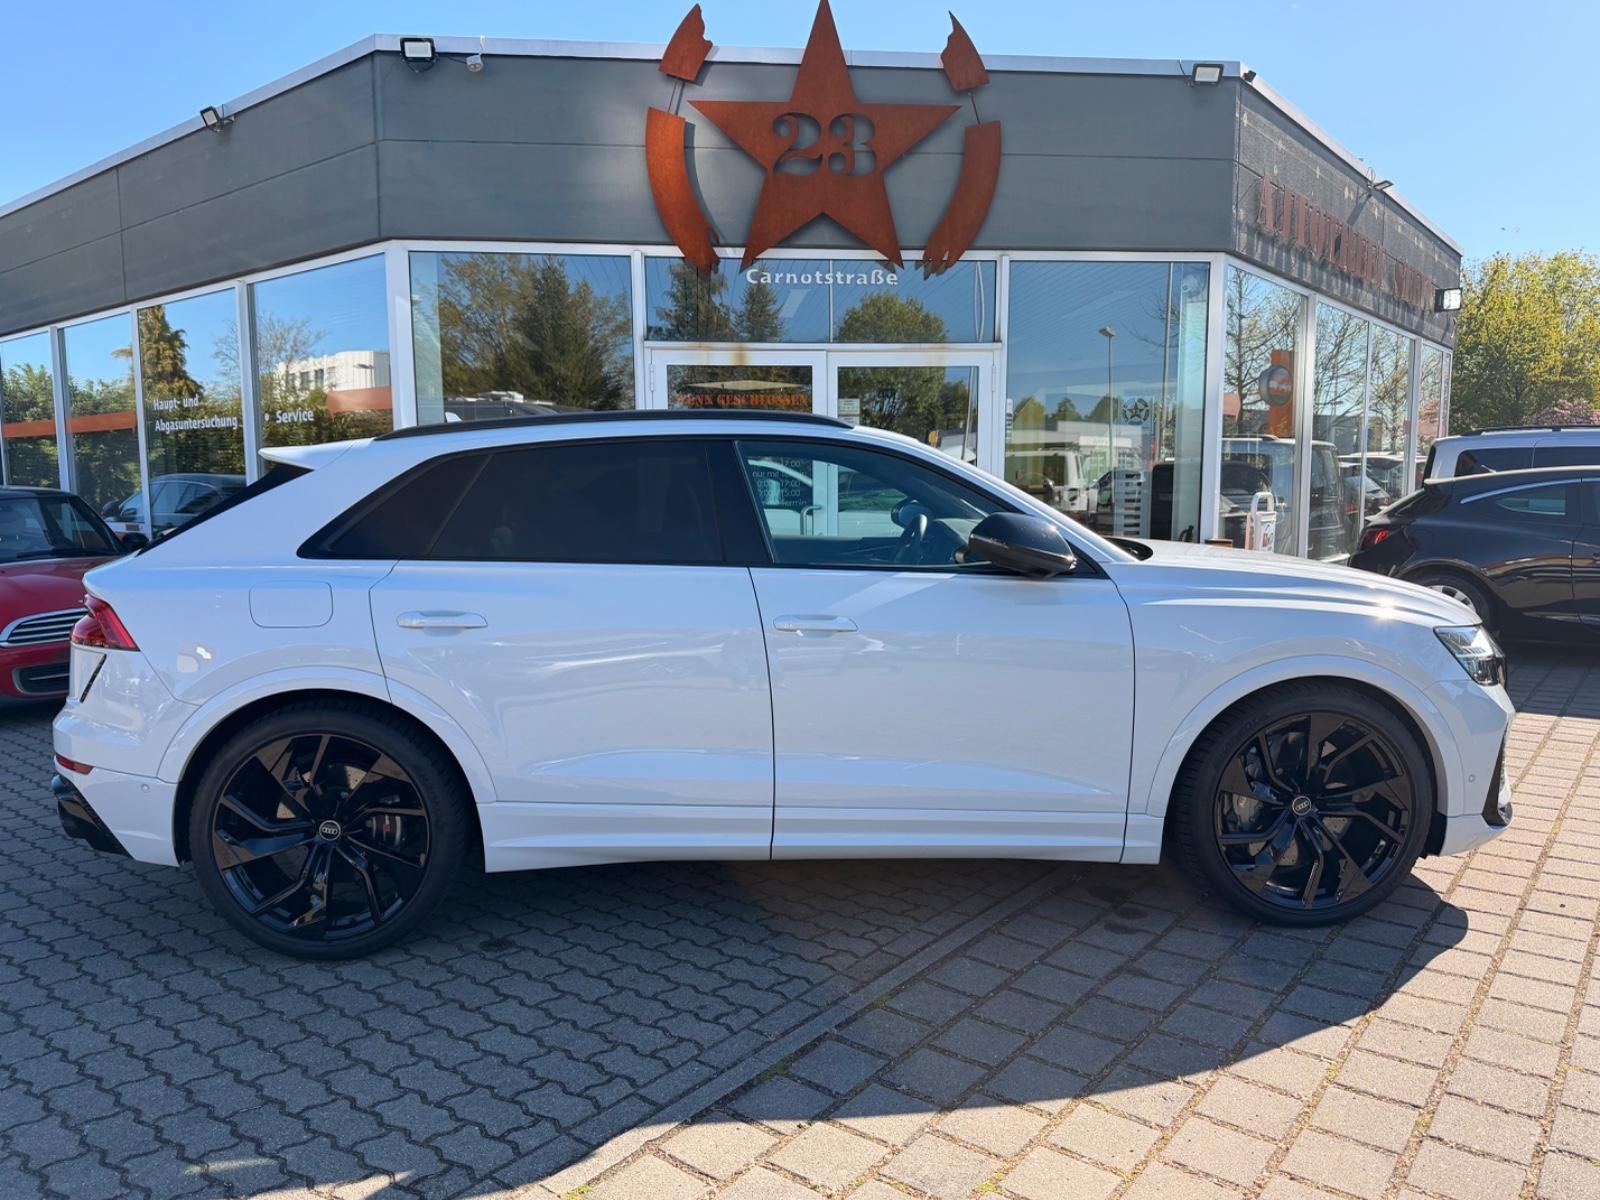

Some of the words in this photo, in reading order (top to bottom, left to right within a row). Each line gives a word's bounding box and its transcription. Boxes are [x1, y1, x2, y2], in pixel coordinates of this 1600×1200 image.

[772, 111, 877, 177] 23
[746, 268, 899, 286] Carnotstraße
[153, 398, 181, 411] Haupt-
[183, 394, 199, 407] und
[155, 414, 238, 434] Abgasuntersuchung
[276, 407, 315, 424] Service
